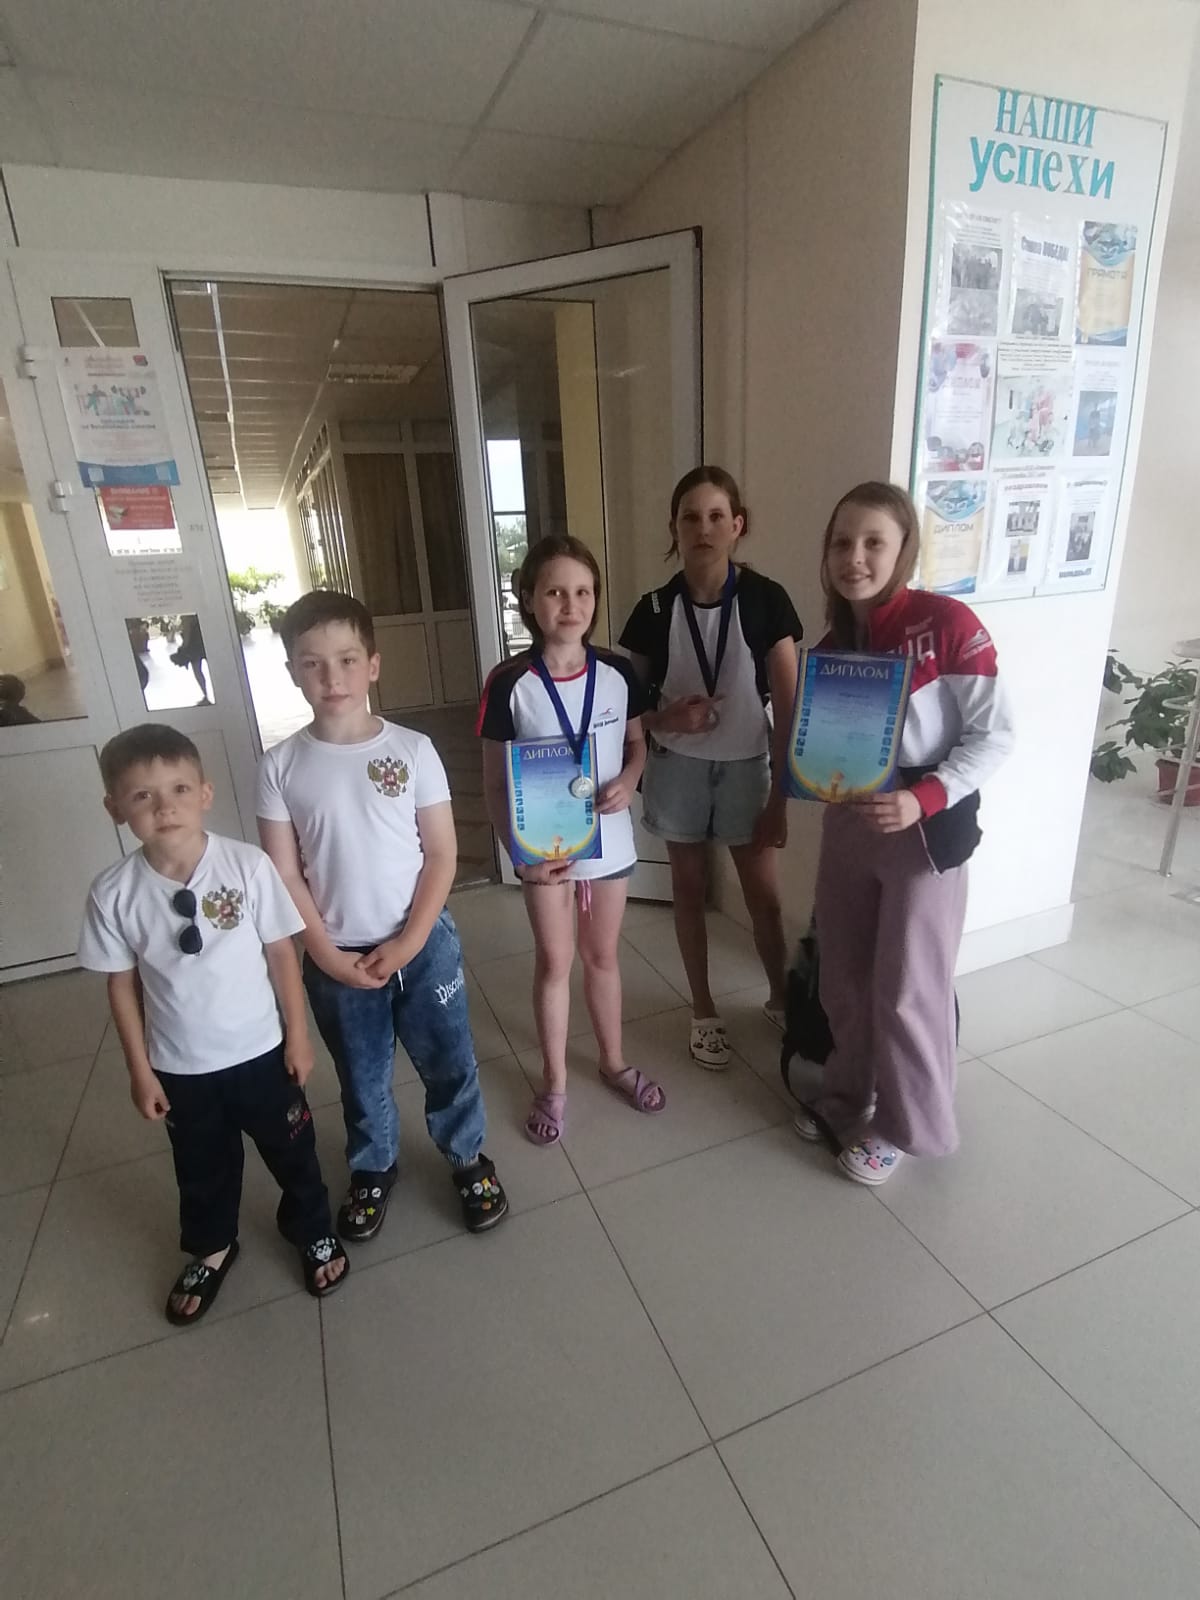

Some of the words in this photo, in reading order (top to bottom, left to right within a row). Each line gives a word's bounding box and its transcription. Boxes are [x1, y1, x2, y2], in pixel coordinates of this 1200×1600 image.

[994, 87, 1099, 148] НАШИ
[934, 522, 974, 535] ДИПЛОМ
[819, 663, 889, 680] ДИПЛОМ
